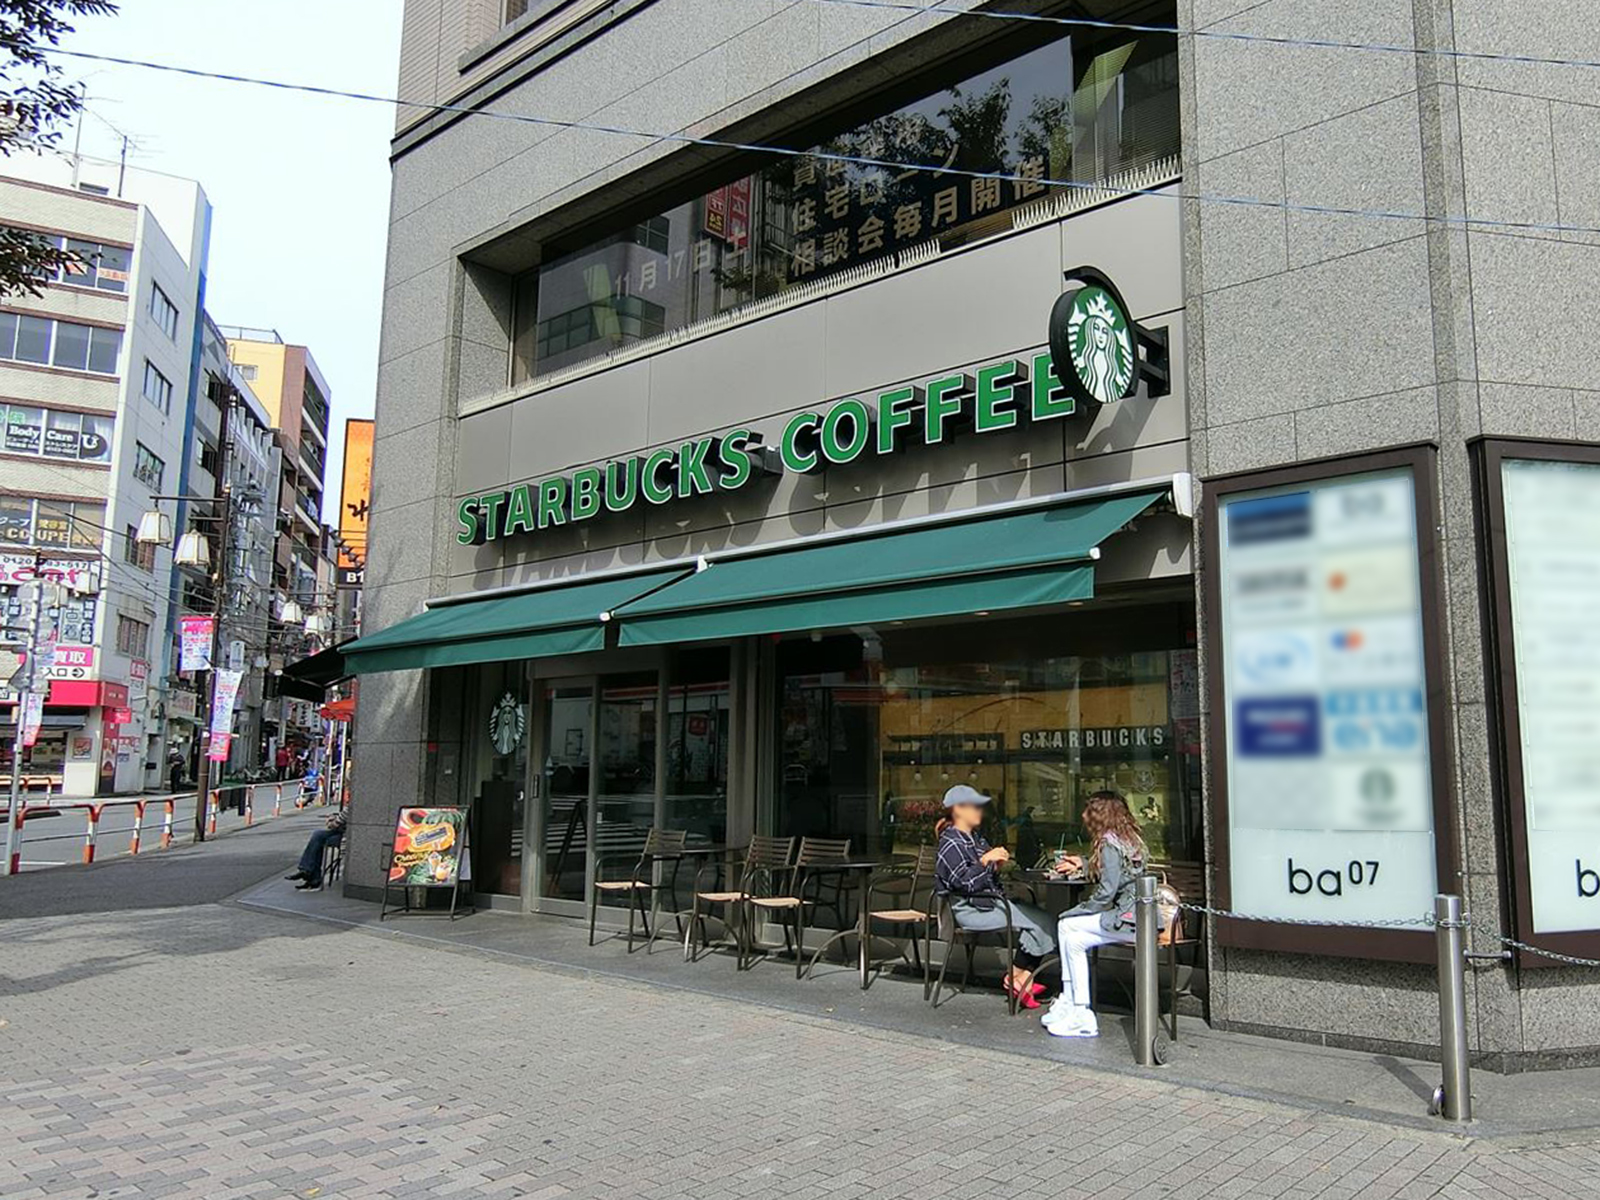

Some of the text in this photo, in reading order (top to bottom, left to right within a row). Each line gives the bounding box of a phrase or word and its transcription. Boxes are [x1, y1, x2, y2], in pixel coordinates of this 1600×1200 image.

[790, 155, 1046, 278] 相談会毎月開催
[9, 425, 74, 442] Body Care
[456, 352, 1076, 545] STARBUCKS COFFEE
[7, 527, 69, 543] COUPE
[45, 667, 68, 678] 入口
[1022, 727, 1164, 748] STARBUCKS
